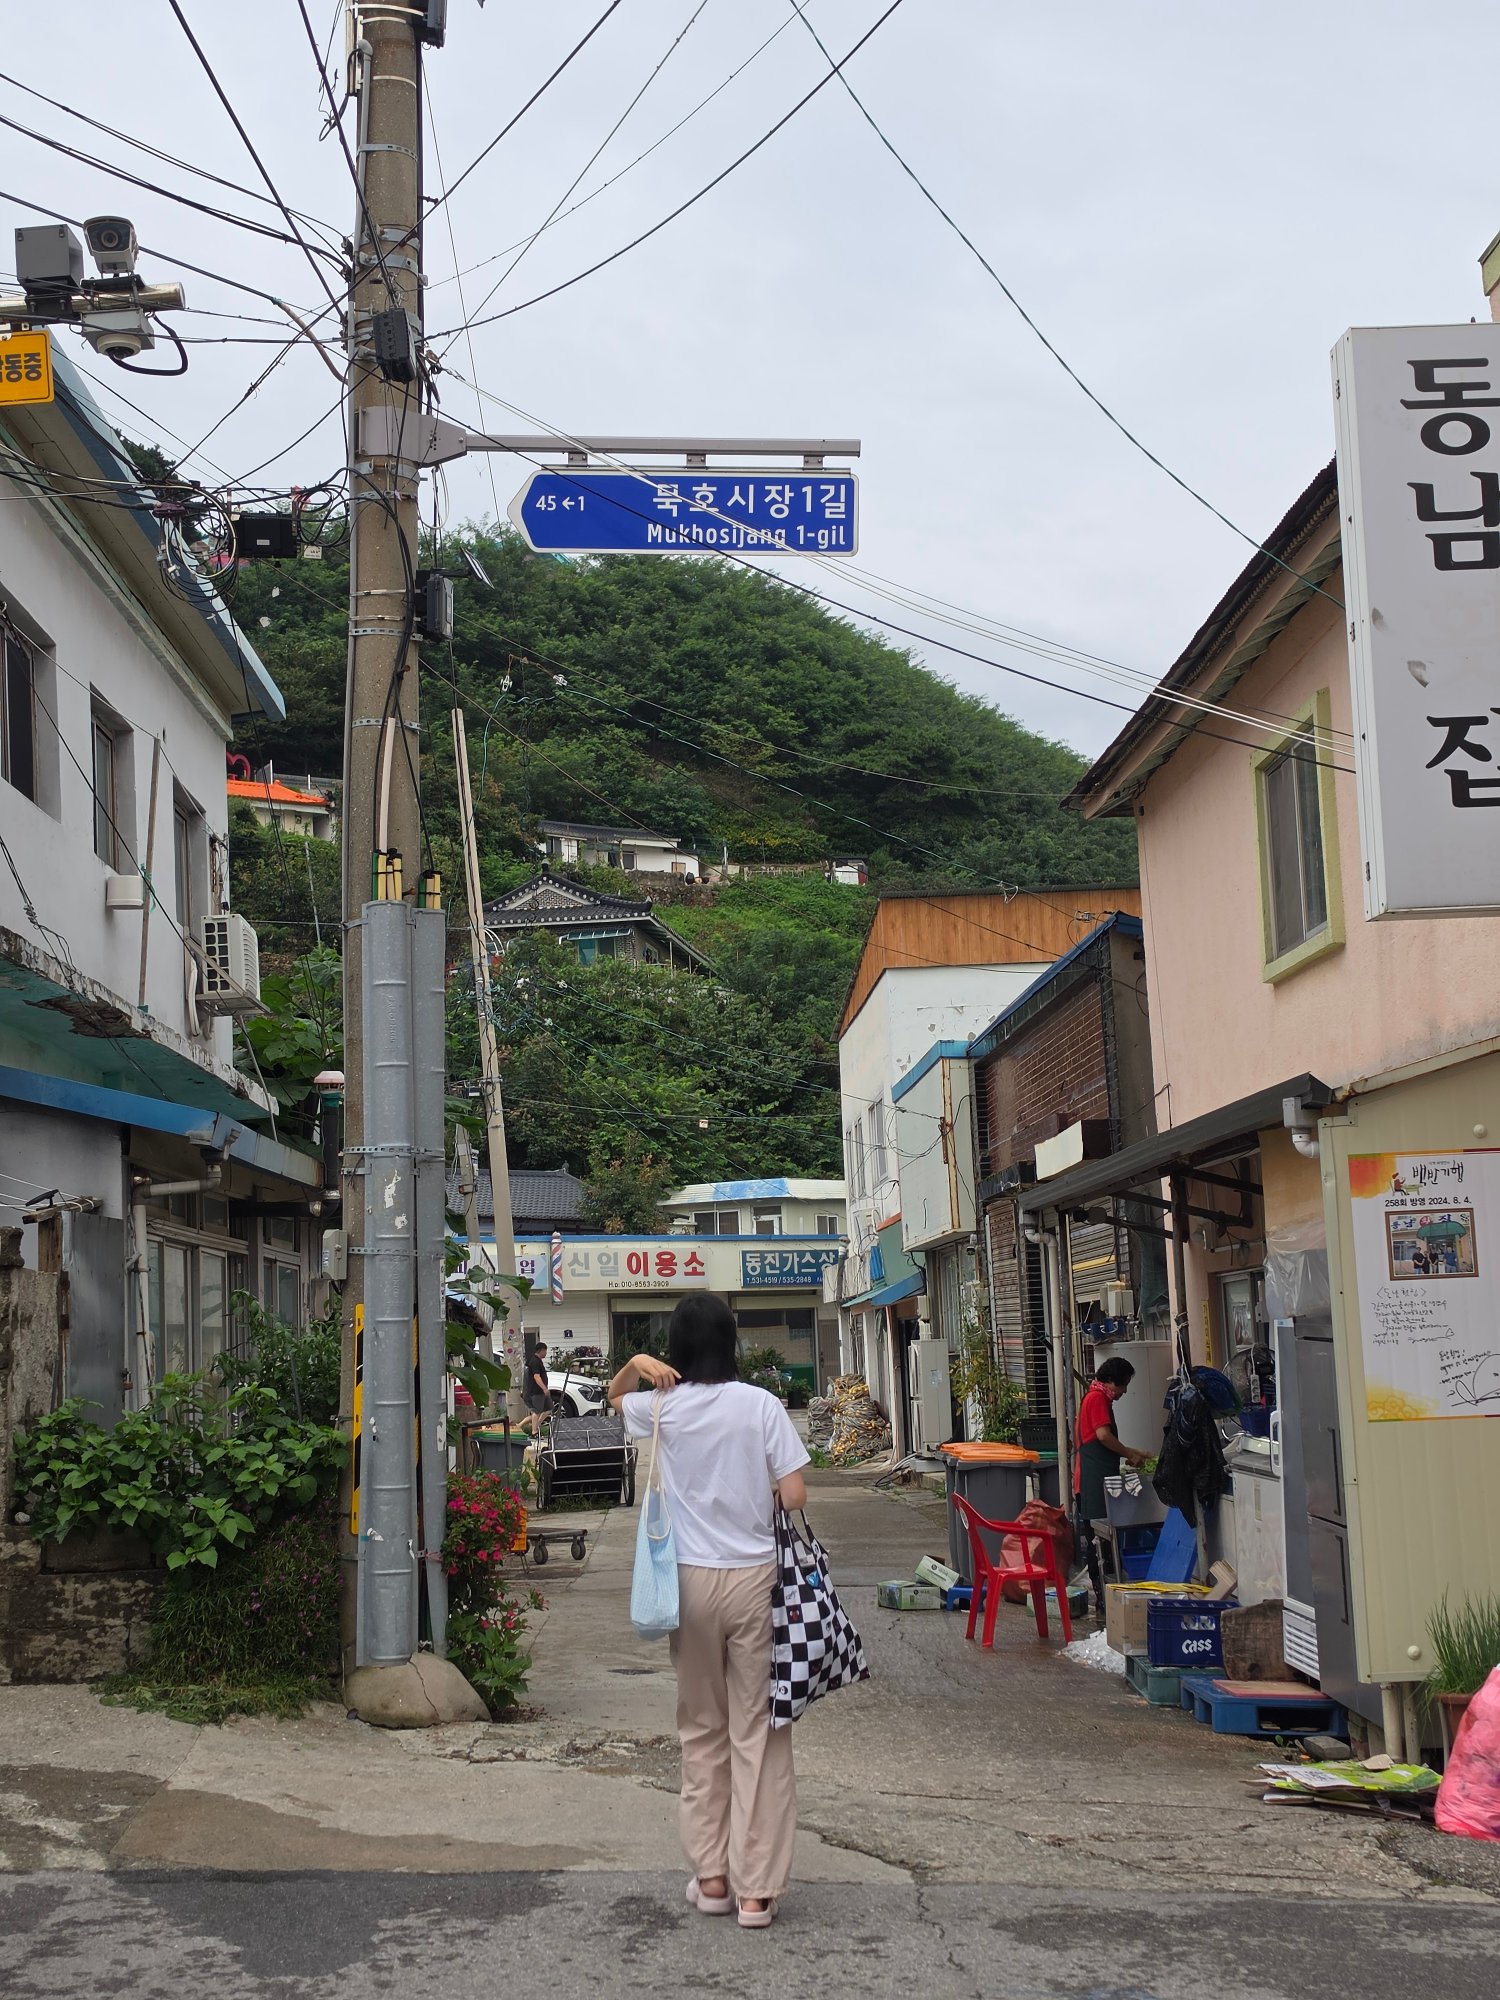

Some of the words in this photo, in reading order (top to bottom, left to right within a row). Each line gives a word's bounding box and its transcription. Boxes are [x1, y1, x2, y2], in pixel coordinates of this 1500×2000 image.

[0, 352, 42, 383] 동중
[536, 495, 557, 511] 45
[577, 495, 585, 511] 1
[652, 482, 847, 519] 묵호시장1길
[647, 523, 786, 550] Mukhosijang
[796, 524, 846, 550] 1-gil
[1412, 1160, 1464, 1187] 백반기행
[567, 1251, 620, 1278] 신일
[626, 1250, 706, 1278] 이용소
[745, 1251, 837, 1275] 동진가스상
[1181, 1638, 1212, 1654] Cass
